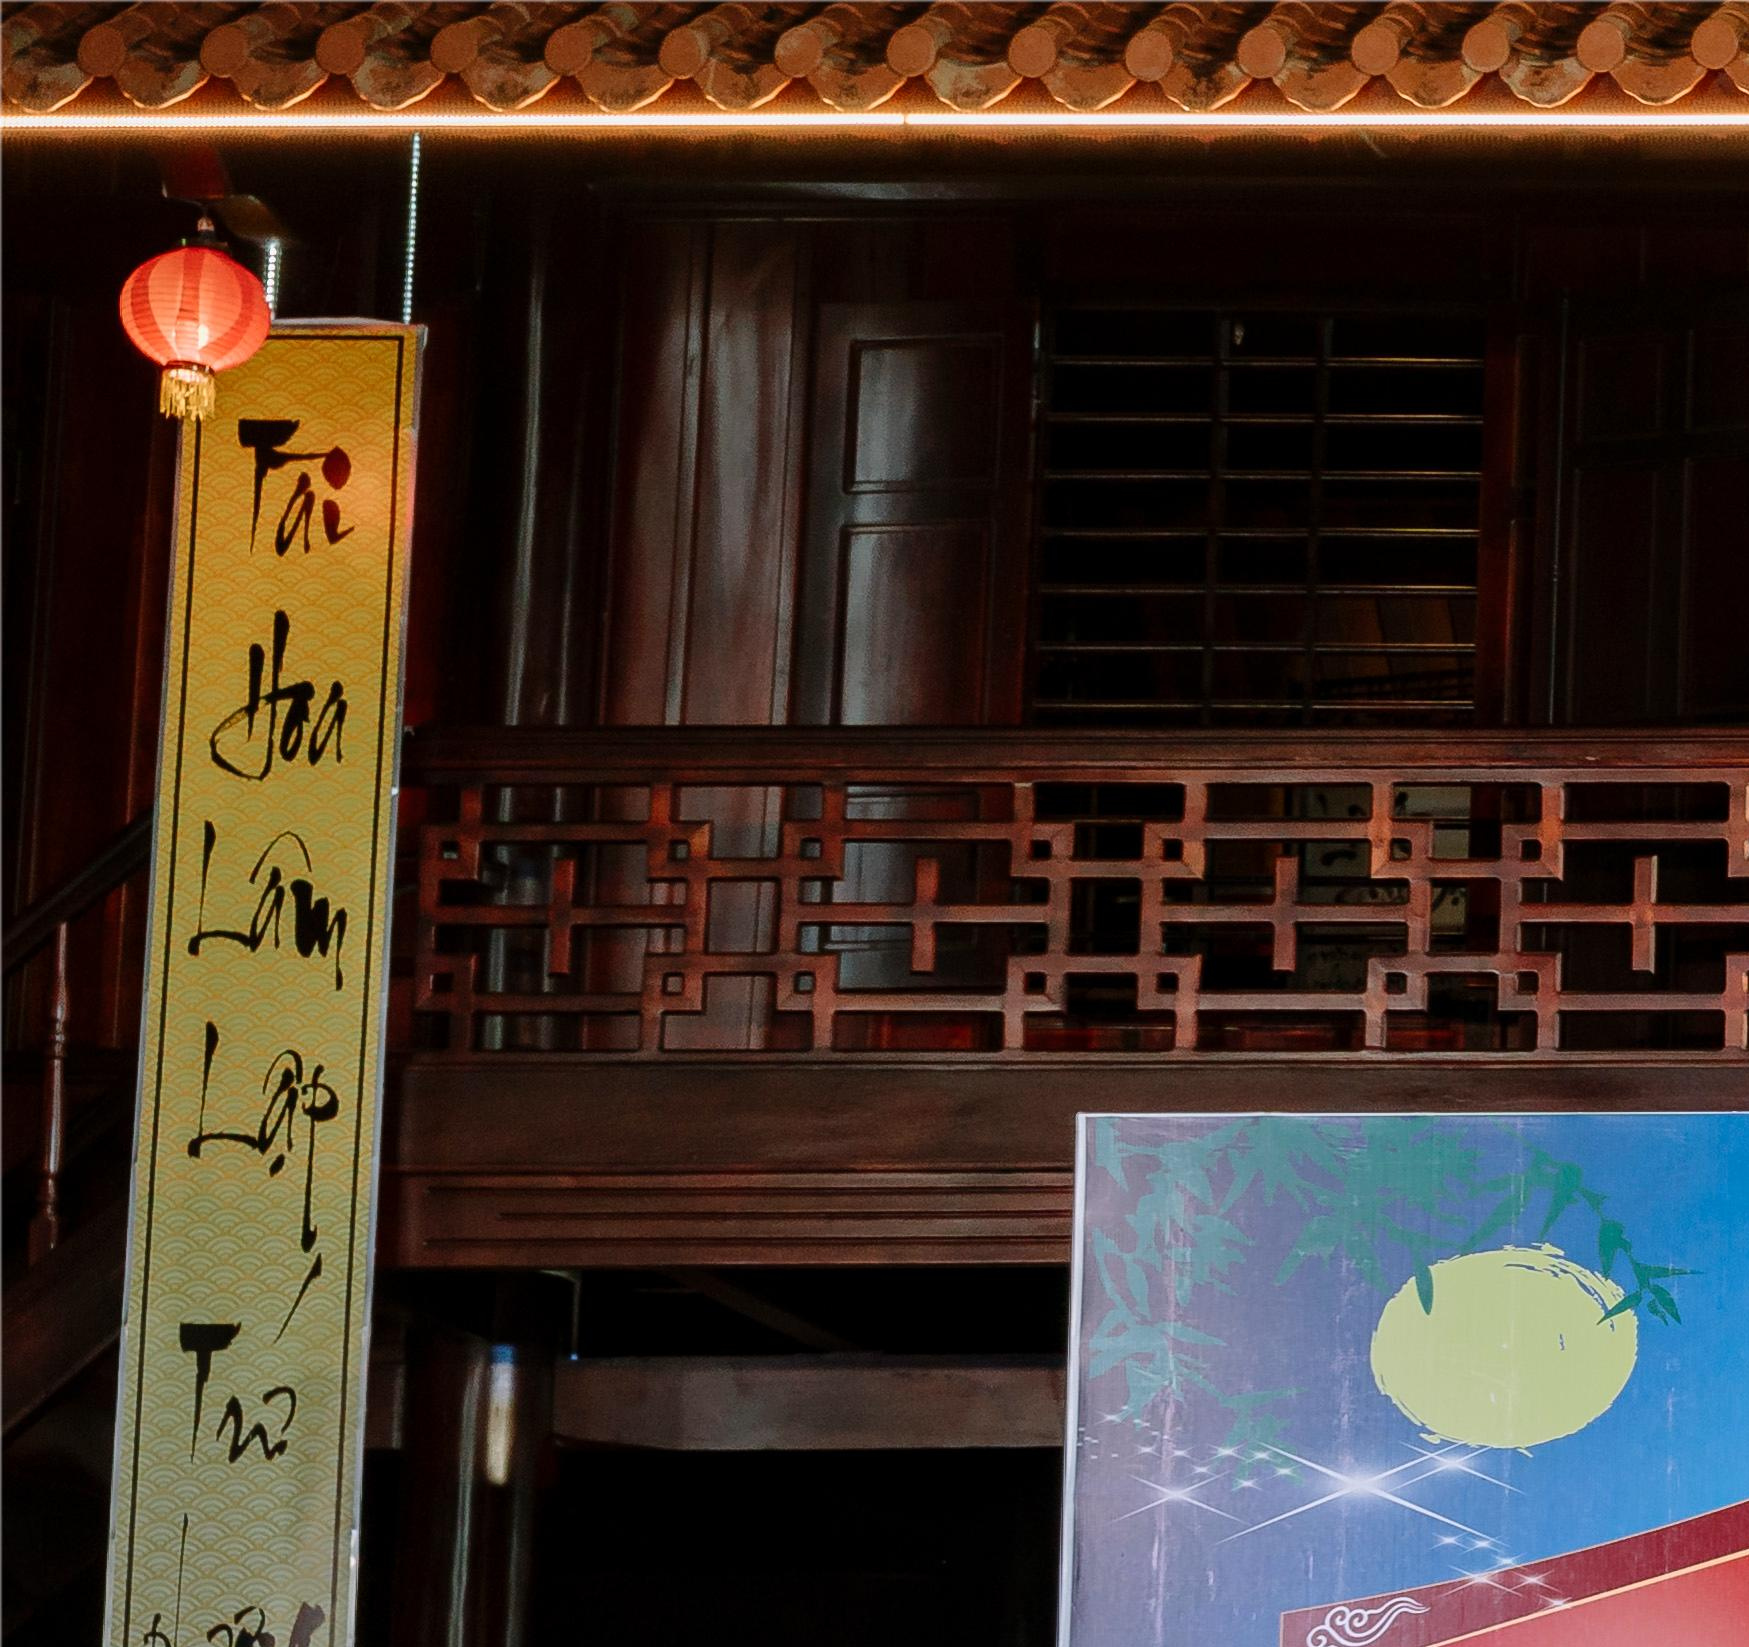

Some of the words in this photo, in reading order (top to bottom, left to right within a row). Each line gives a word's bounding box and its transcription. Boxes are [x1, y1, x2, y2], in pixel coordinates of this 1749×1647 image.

[238, 418, 354, 556] Tài
[210, 609, 347, 781] Hoa
[188, 820, 347, 991] Lâm
[188, 1021, 339, 1253] Lập
